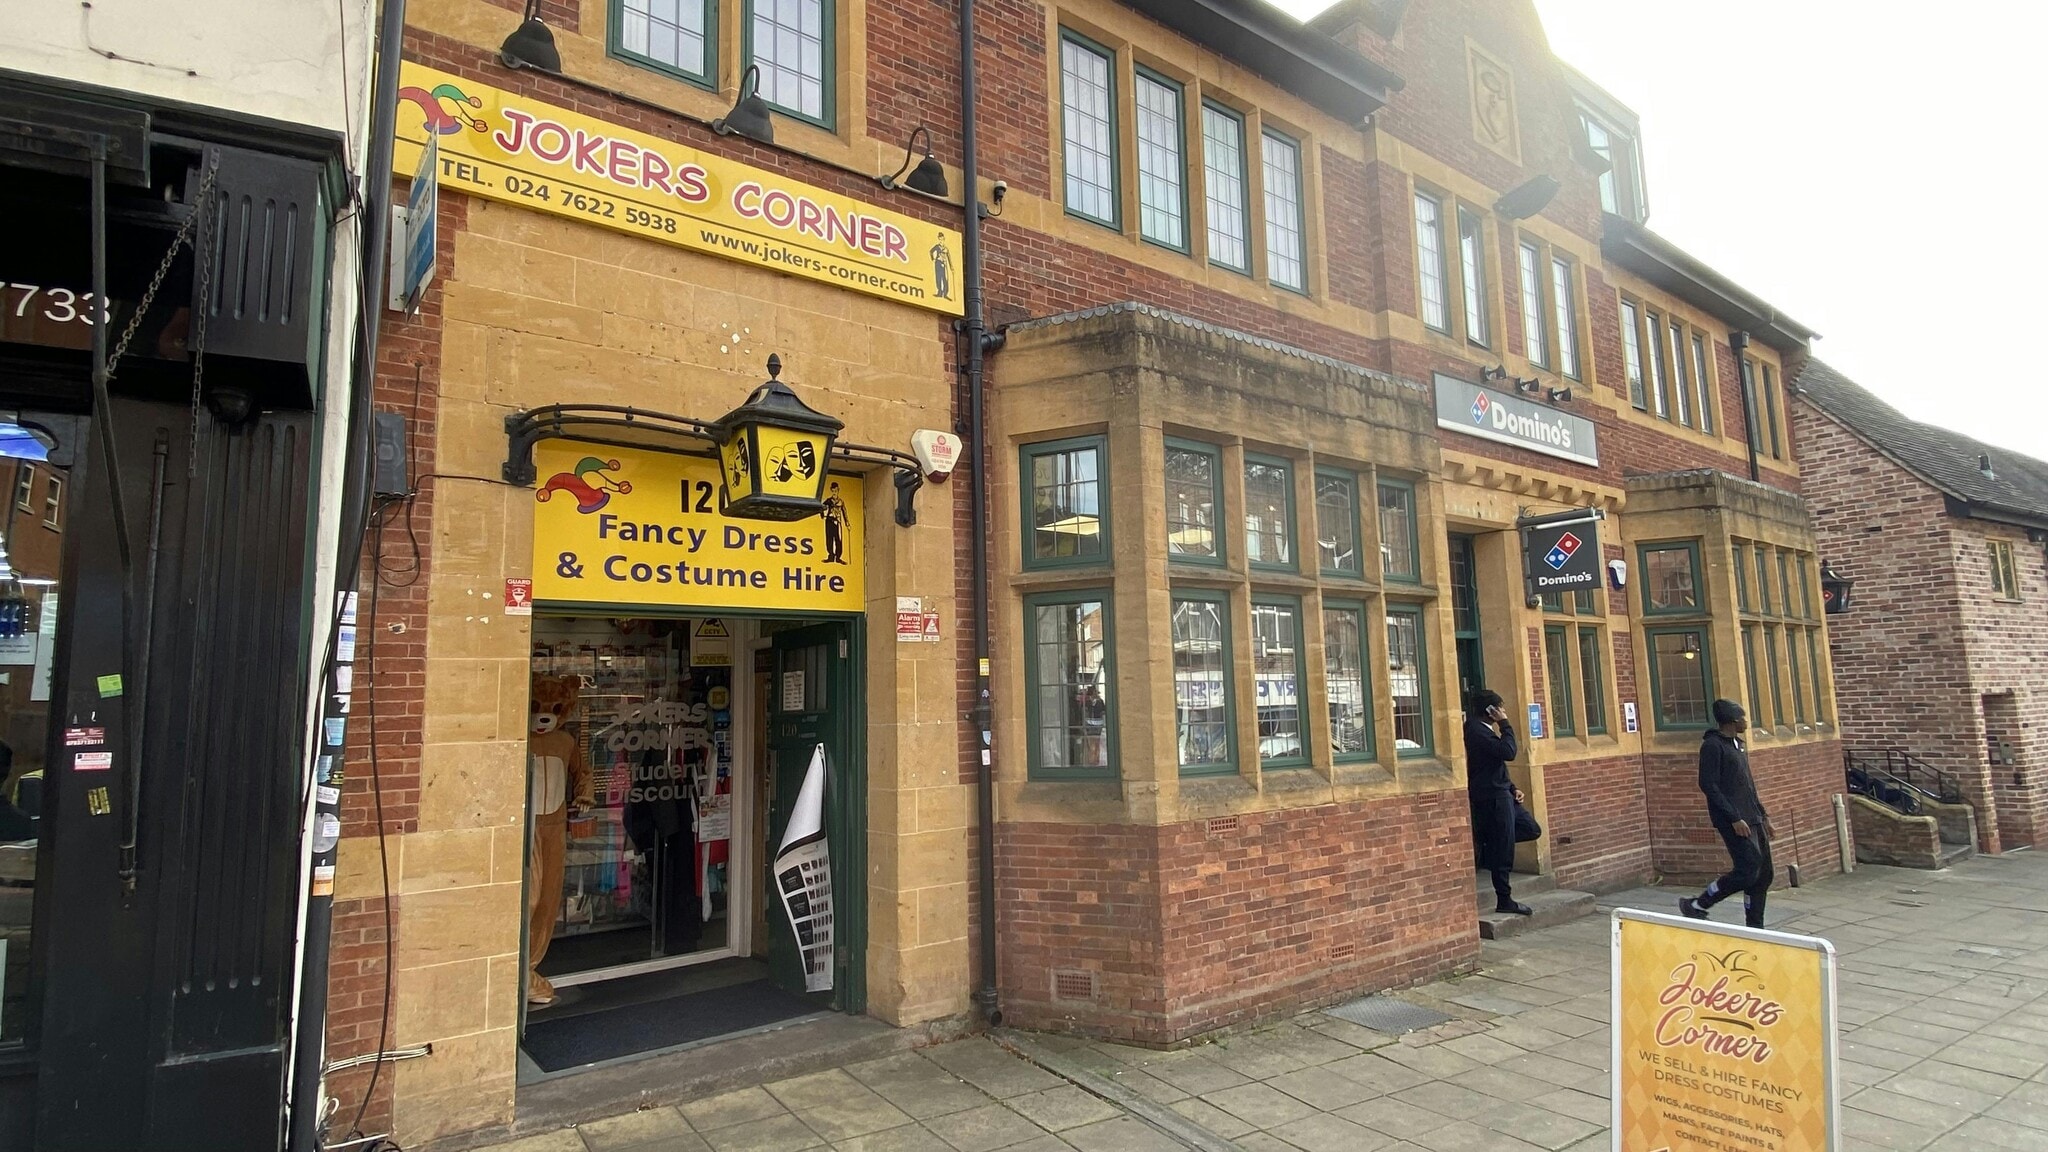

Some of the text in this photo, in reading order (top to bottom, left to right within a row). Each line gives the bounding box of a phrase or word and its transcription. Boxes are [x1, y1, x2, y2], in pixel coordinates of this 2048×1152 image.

[439, 157, 677, 234] TEL. 024 7622 5938
[494, 107, 709, 203] JOKERS
[732, 182, 909, 264] CORNER
[700, 230, 925, 299] www.jokers-corner.com
[0, 281, 111, 326] 733
[1491, 401, 1571, 448] Domino's
[599, 513, 814, 555] Fancy Dress
[556, 551, 845, 593] & Costume Hire
[1538, 571, 1592, 587] Domino's
[610, 702, 708, 725] JOKERS
[608, 727, 712, 752] CORNER
[613, 760, 708, 781] Student
[1659, 962, 1785, 1026] Jokers
[1655, 1004, 1772, 1064] Corner
[1639, 1051, 1803, 1102] WE SELL & HIRE FANCY
[1654, 1069, 1785, 1114] DRESS COSTUMES
[1653, 1094, 1786, 1140] WIGS, ACCESSORIES, HATS,
[1662, 1111, 1775, 1151] MASKS, FACE PAINTS &
[1675, 1129, 1720, 1149] CONTACT
